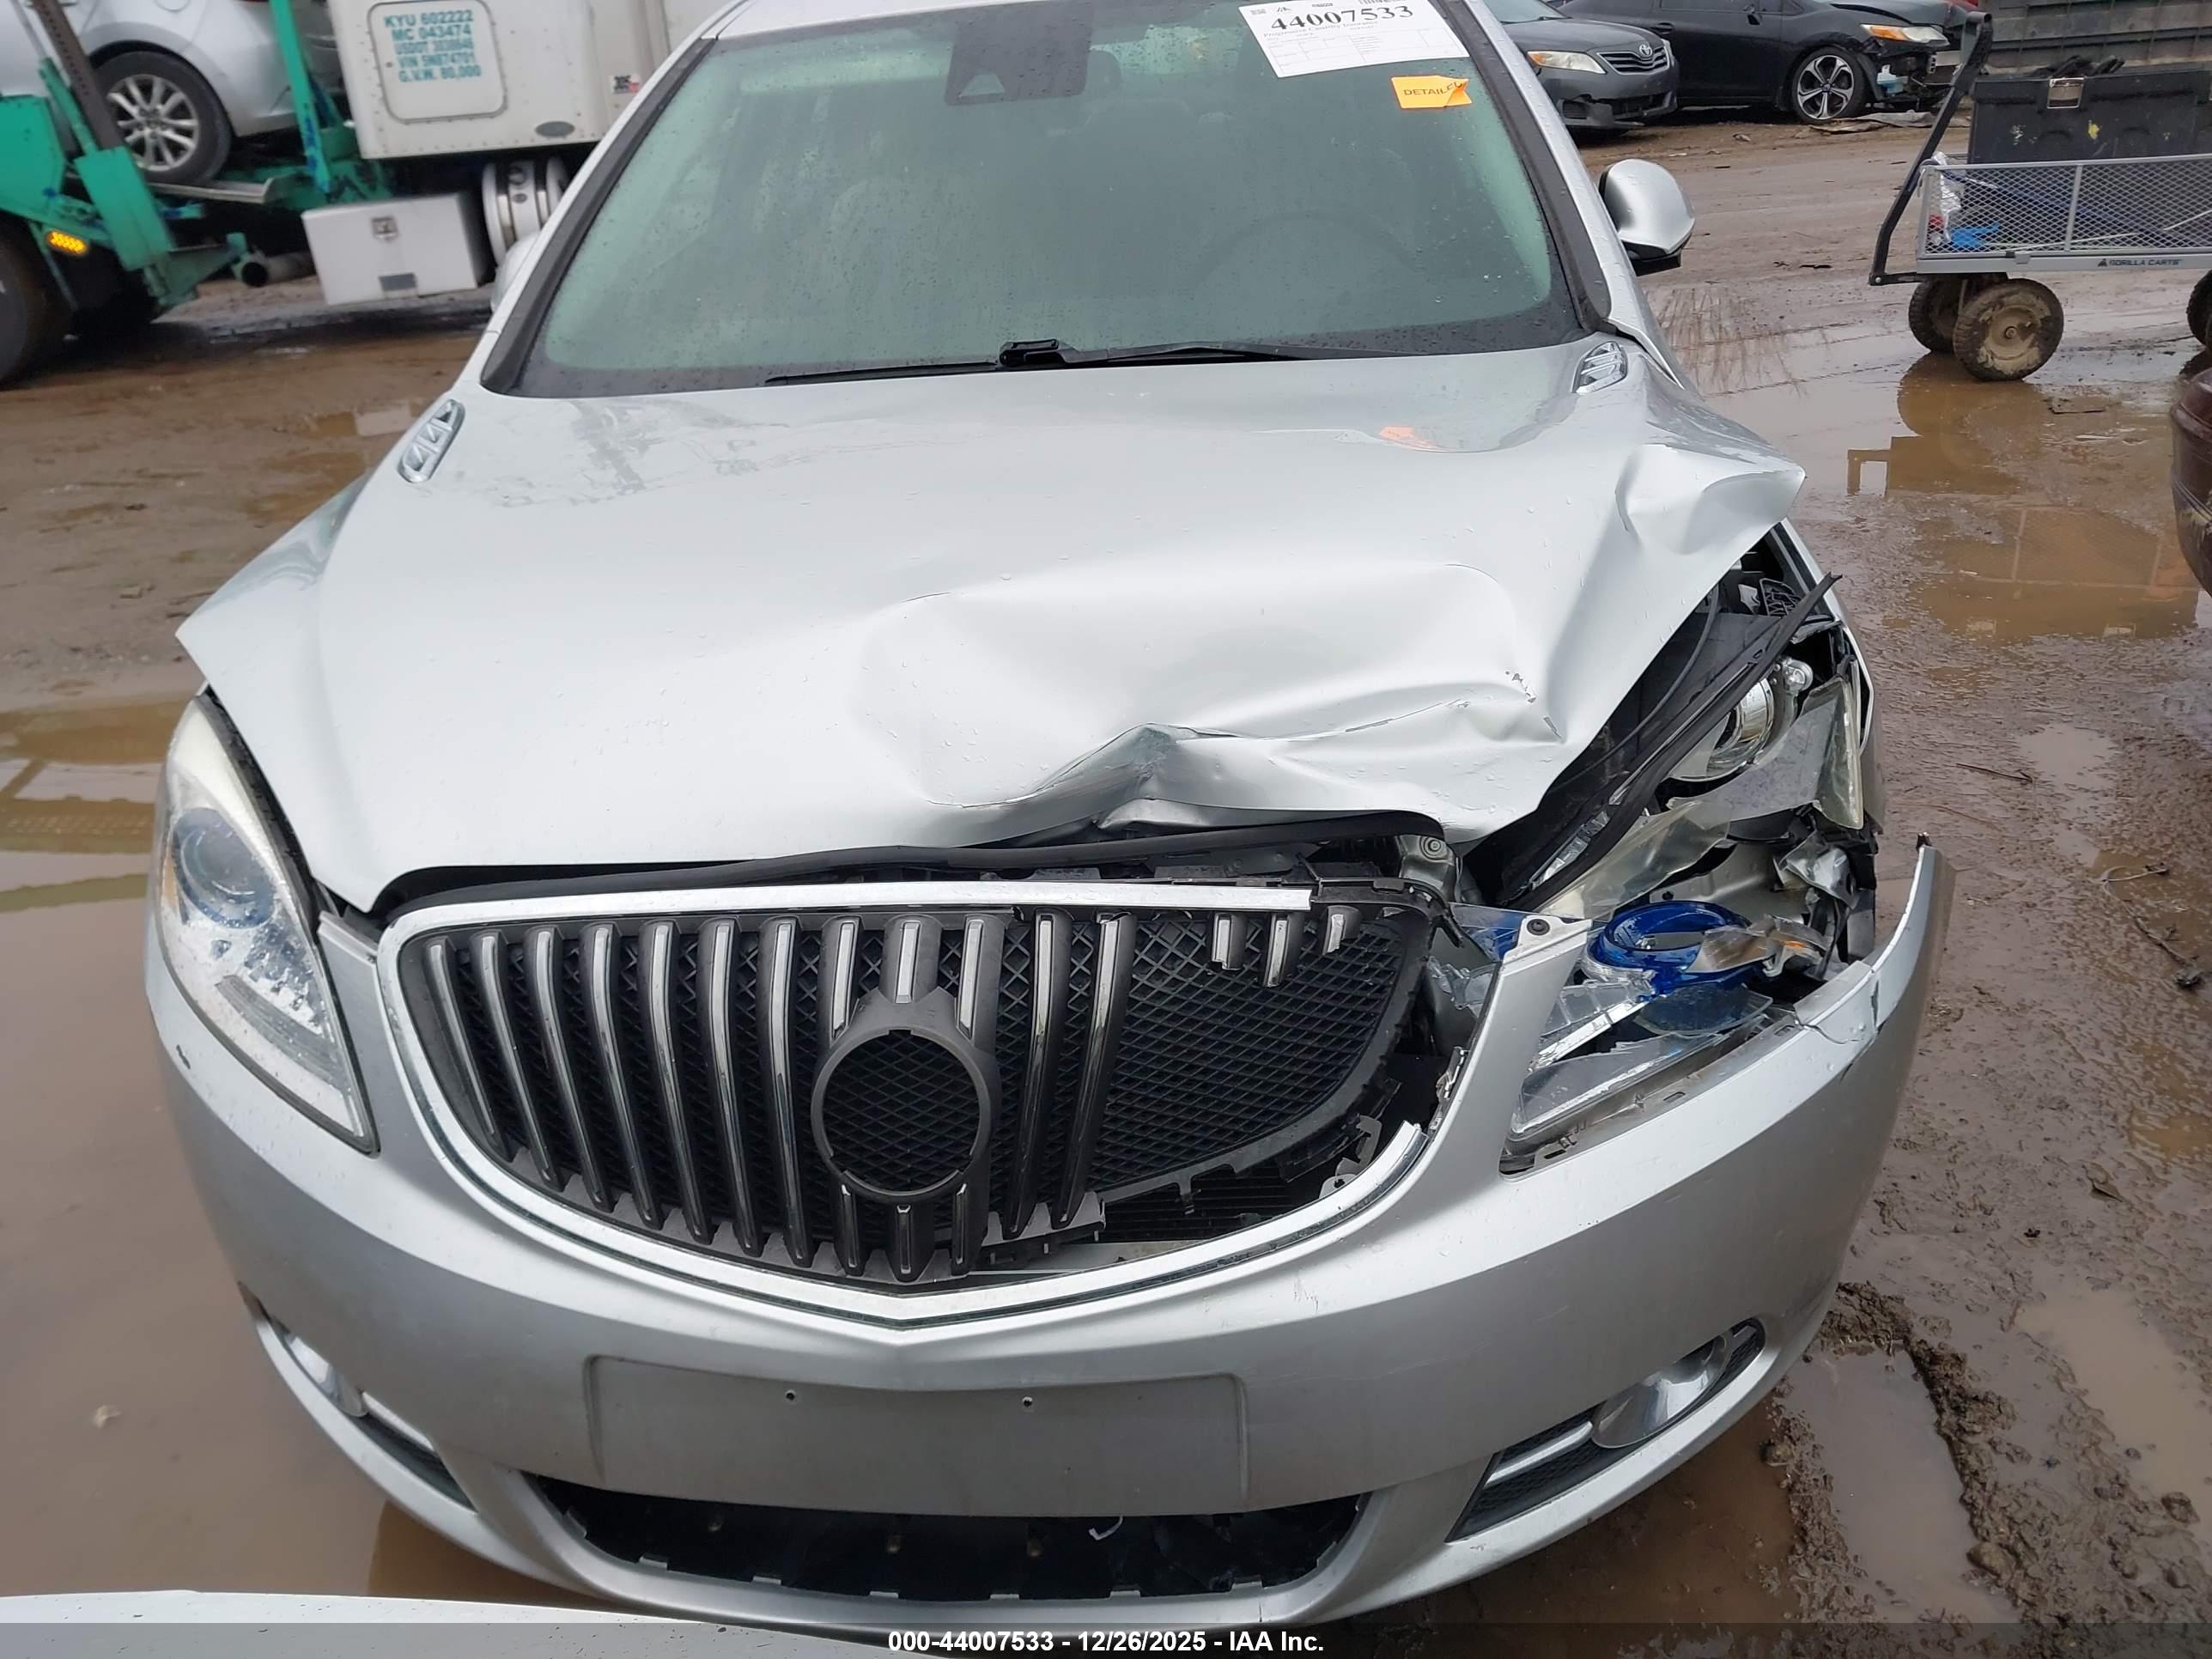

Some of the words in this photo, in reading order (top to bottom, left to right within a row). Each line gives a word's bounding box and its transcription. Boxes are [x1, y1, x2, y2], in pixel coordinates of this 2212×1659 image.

[385, 15, 416, 27] KYU
[1272, 5, 1413, 29] 44007533
[392, 28, 414, 41] MC
